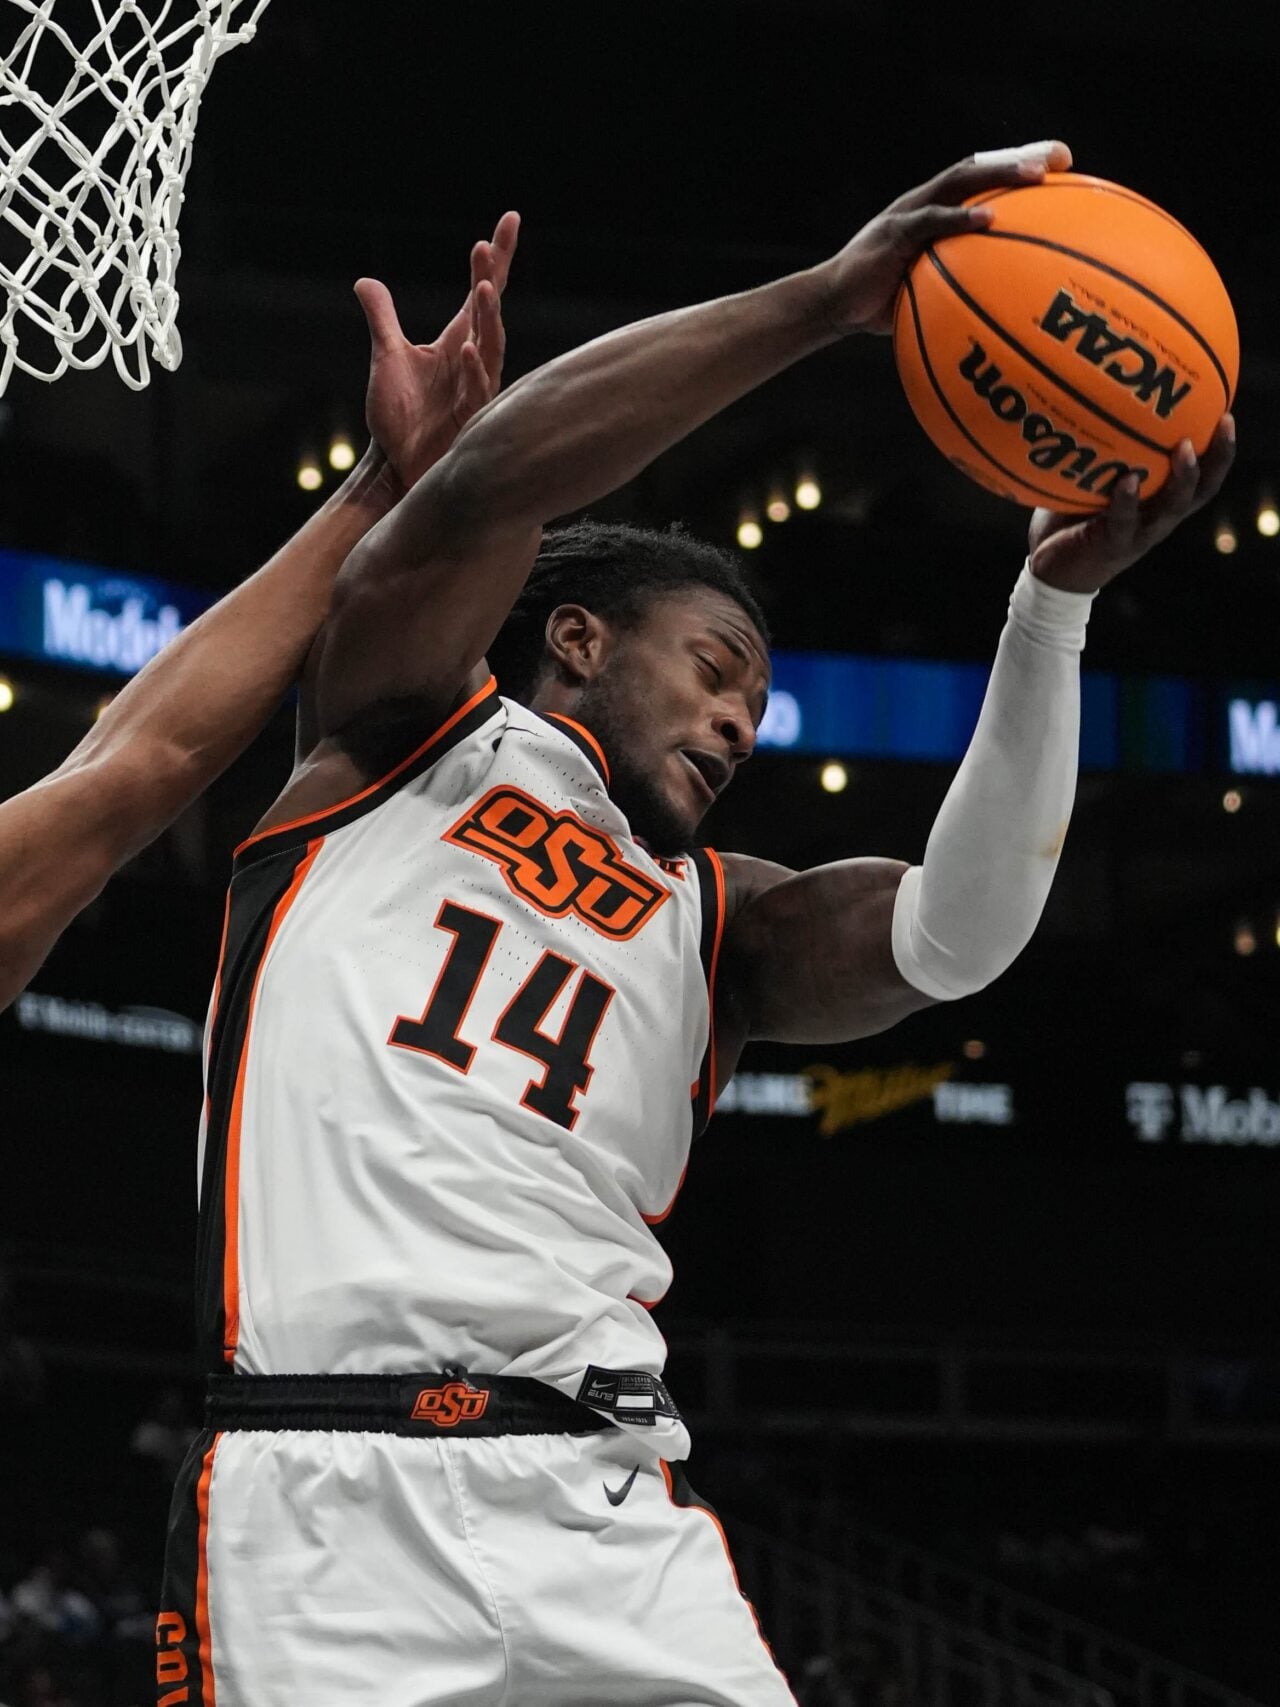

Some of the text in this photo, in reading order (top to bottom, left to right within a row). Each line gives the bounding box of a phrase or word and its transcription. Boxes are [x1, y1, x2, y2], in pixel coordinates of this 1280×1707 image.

[959, 342, 1150, 497] Wilson
[1039, 287, 1193, 420] NCAA
[42, 578, 186, 673] Model
[440, 784, 672, 942] OSU
[386, 897, 617, 1132] 14
[410, 1382, 490, 1427] OSU
[155, 1610, 189, 1707] CO
